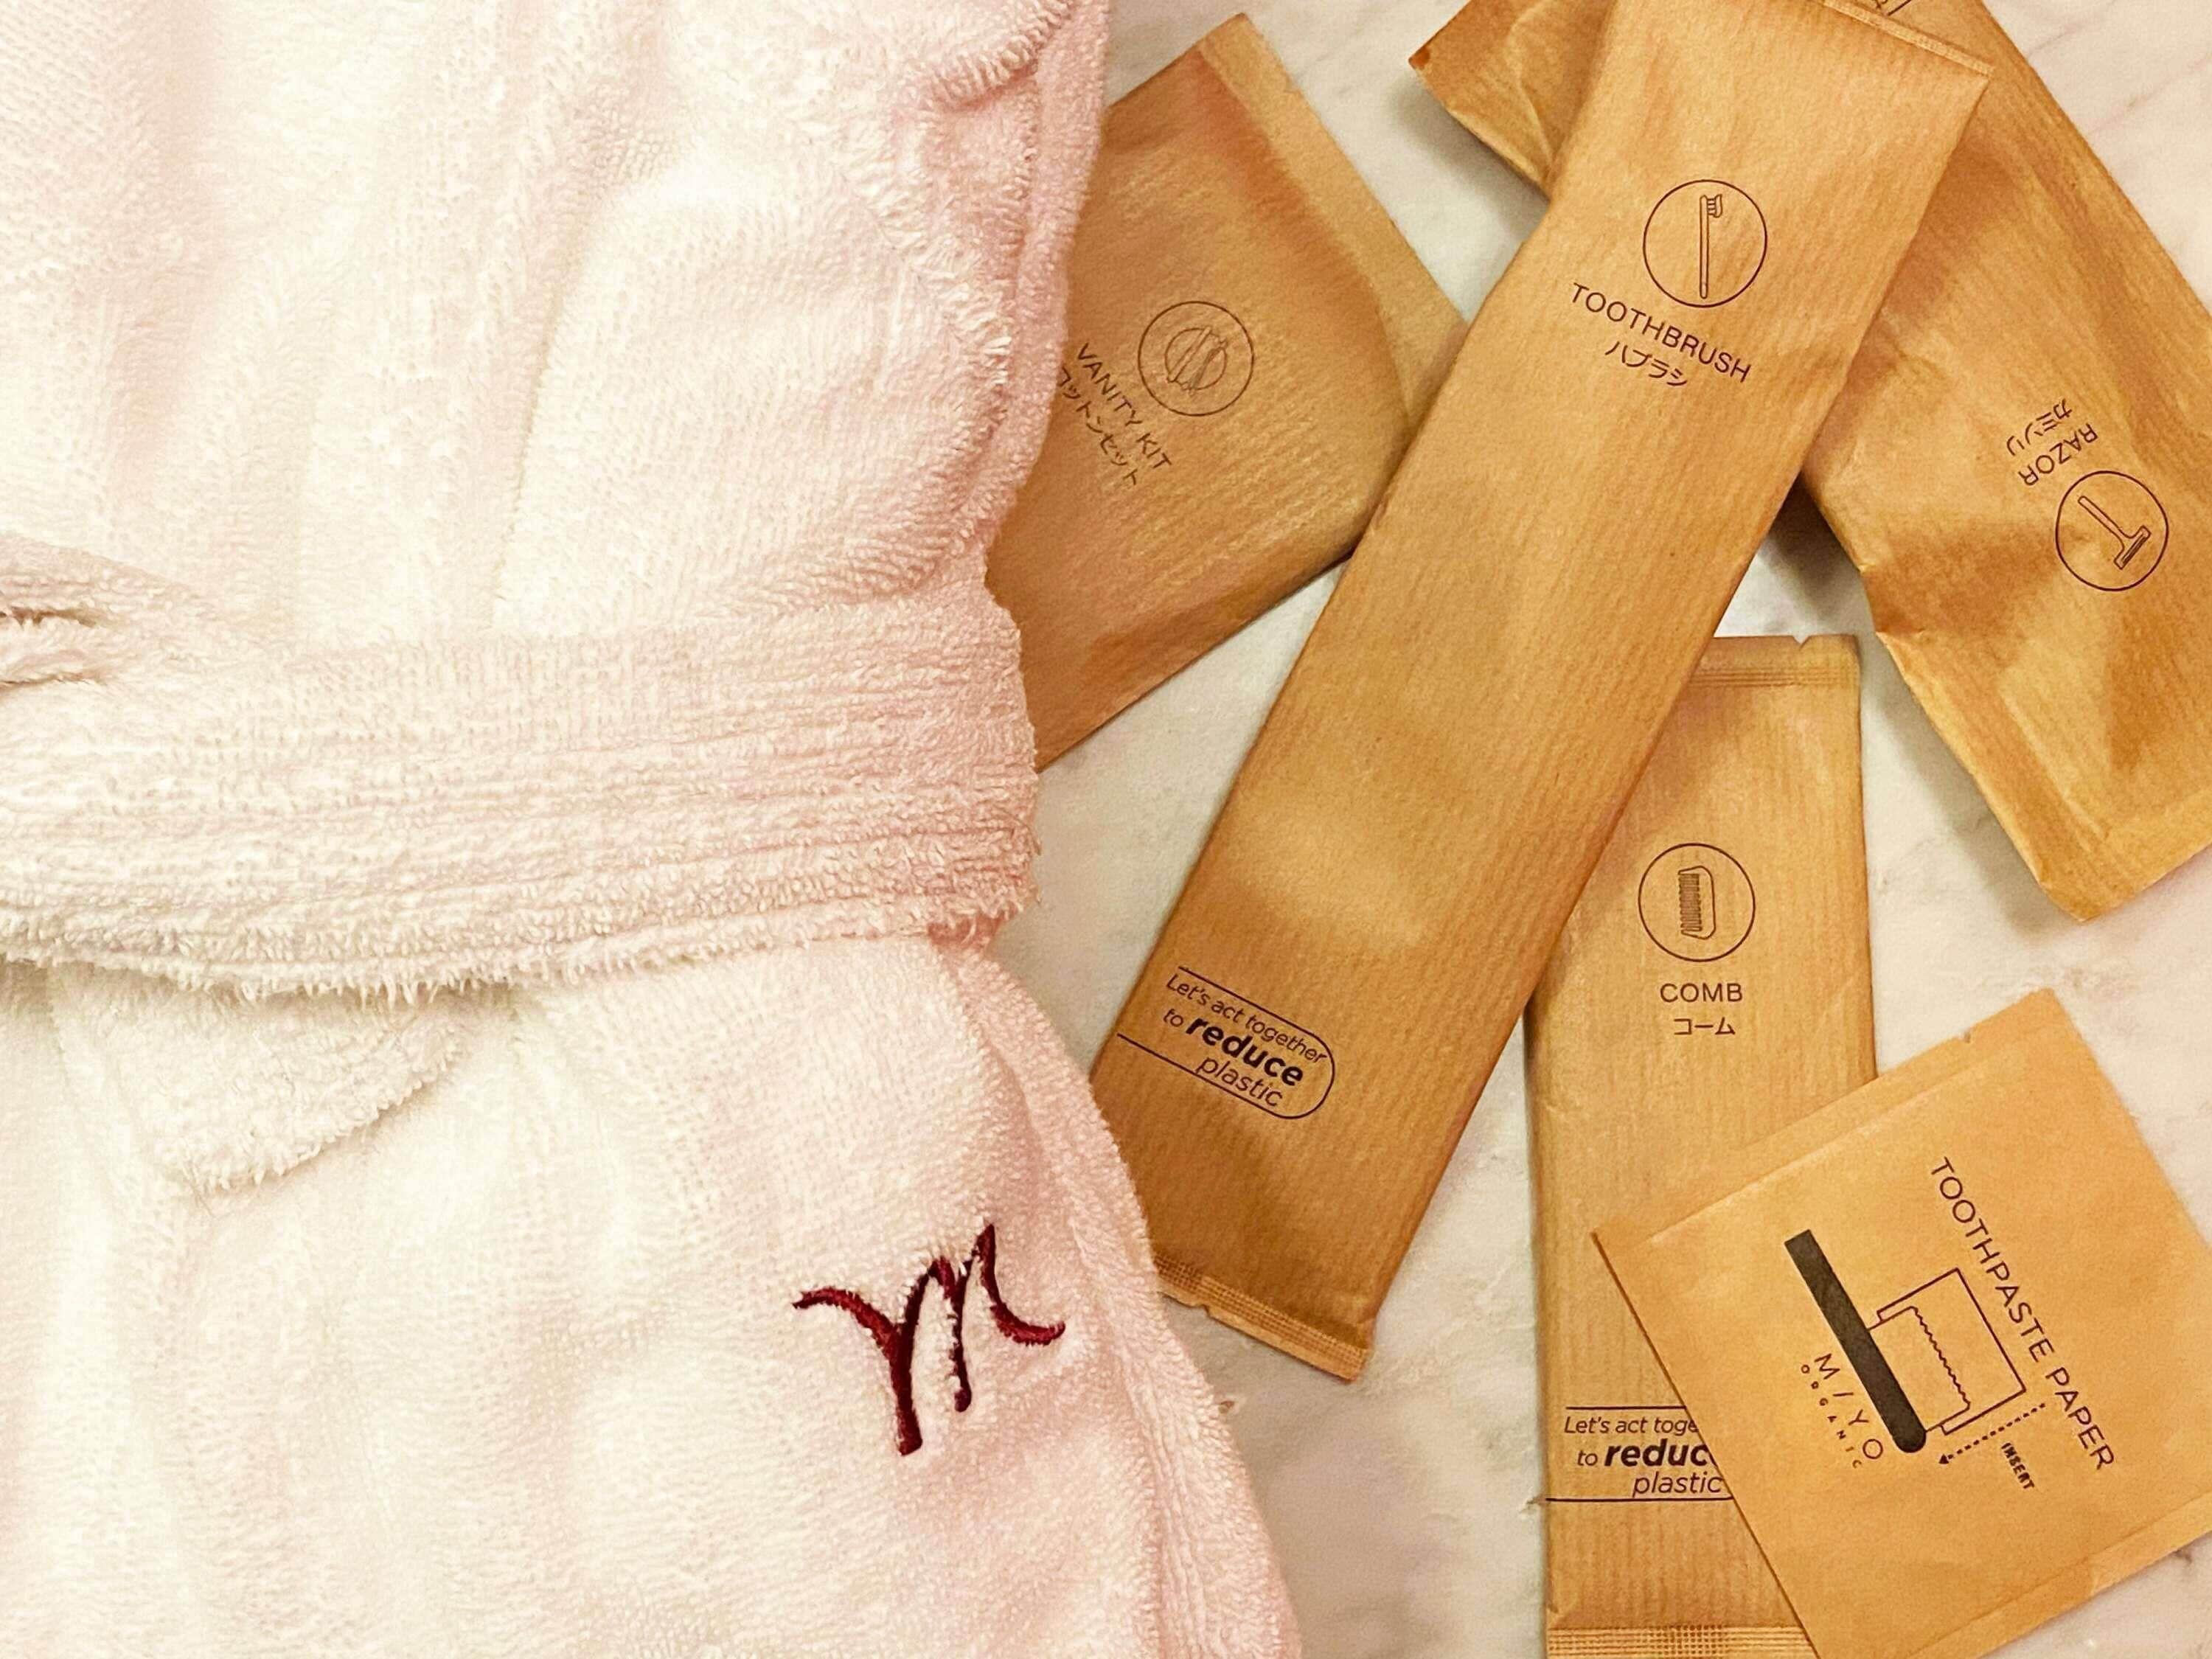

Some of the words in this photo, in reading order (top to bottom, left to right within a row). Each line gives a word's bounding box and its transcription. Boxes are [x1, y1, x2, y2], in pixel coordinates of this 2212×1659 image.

[1572, 282, 1751, 383] TOOTHBRUSH
[1059, 366, 1138, 485] コットンセット
[1077, 342, 1142, 427] VANITY
[1137, 433, 1172, 468] KIT
[2006, 398, 2073, 456] カミソリ
[2017, 423, 2098, 485] RAZOR
[1166, 974, 1211, 1006] Let's
[1211, 999, 1246, 1023] act
[1245, 1015, 1328, 1063] together
[1660, 982, 1743, 1003] COMB
[1163, 1008, 1184, 1028] to
[1185, 1018, 1303, 1086] reduce
[1674, 1017, 1736, 1035] コーム
[1194, 1057, 1283, 1107] plastic
[1930, 1156, 2055, 1363] TOOTHPASTE
[2045, 1366, 2115, 1470] PAPER
[1564, 1416, 1610, 1434] Let's
[1615, 1416, 1648, 1433] act
[1653, 1416, 1699, 1436] toge
[1801, 1364, 1863, 1470] ORGANIC
[1576, 1449, 1599, 1466] to
[1604, 1438, 1717, 1467] reduc
[2000, 1441, 2036, 1490] INSERT
[1632, 1471, 1725, 1498] plastic
